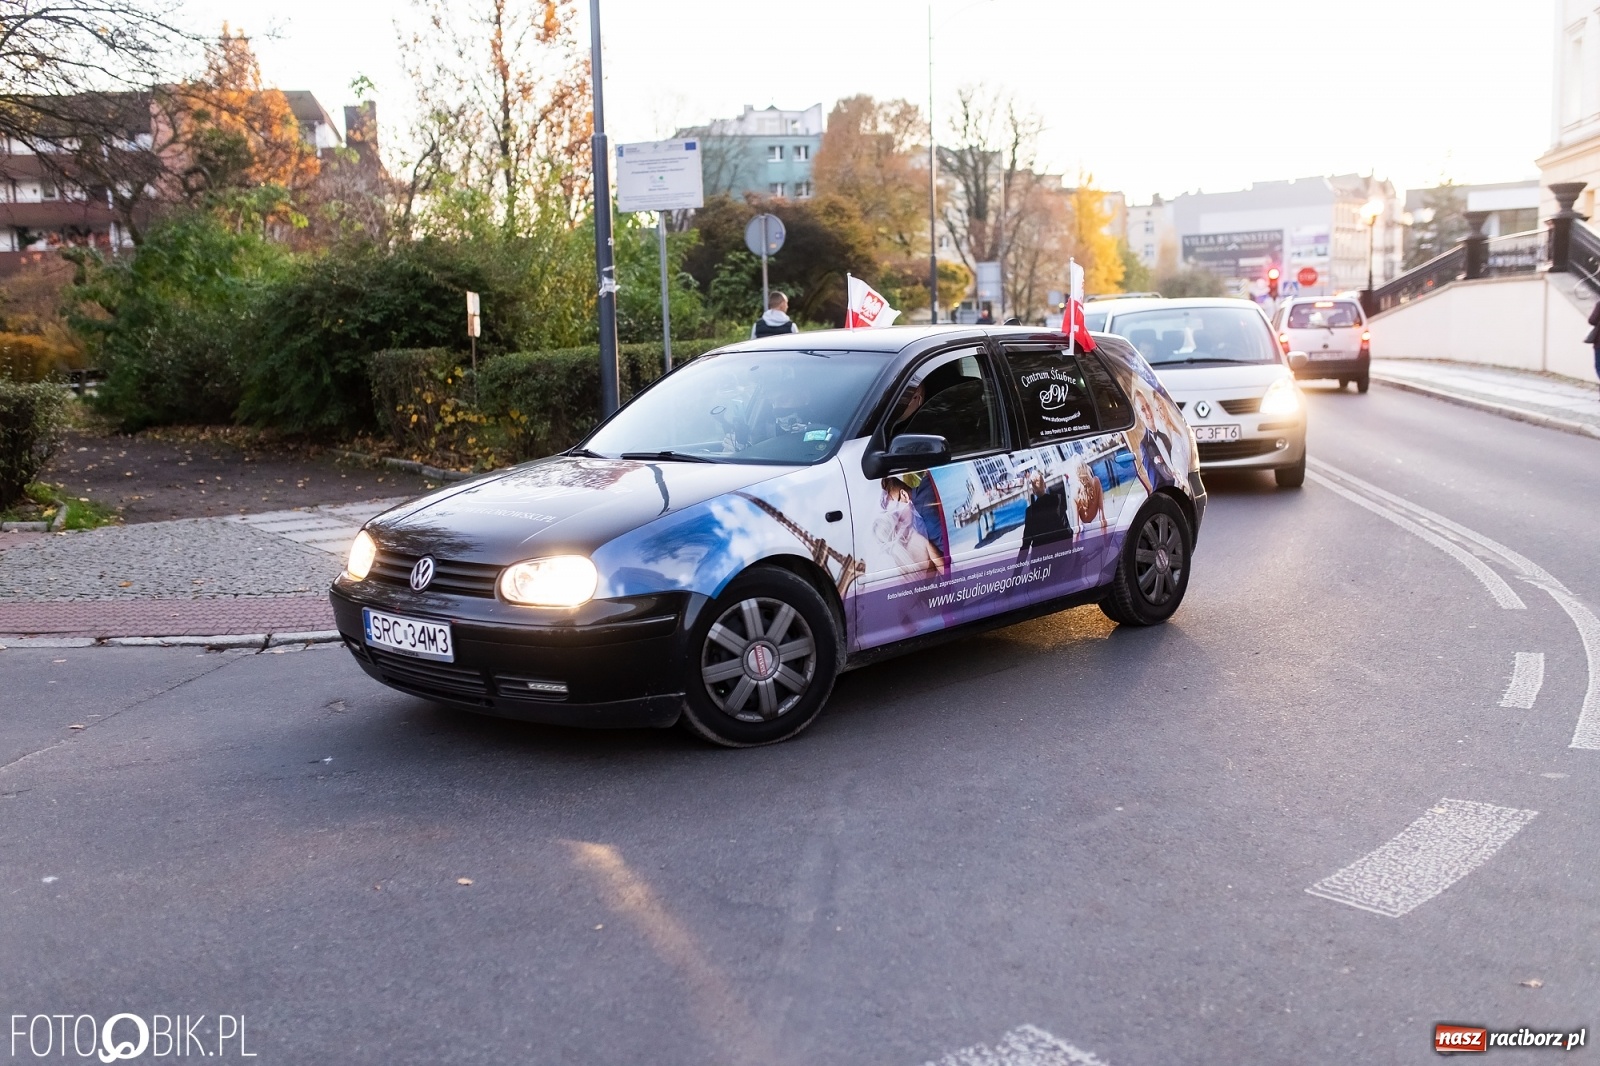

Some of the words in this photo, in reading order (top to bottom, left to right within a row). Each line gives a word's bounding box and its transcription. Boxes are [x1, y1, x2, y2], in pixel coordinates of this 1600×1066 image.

[1021, 372, 1050, 387] Centrum
[1050, 366, 1076, 385] Ślubne
[1208, 427, 1237, 439] 3FT6
[914, 582, 938, 594] fotobudka,
[939, 575, 966, 588] zaproszenia,
[986, 566, 1006, 577] stylizacja,
[1006, 559, 1029, 571] samochody,
[1030, 556, 1042, 565] nauka
[928, 563, 1052, 609] www.studiowegorowski.pl
[372, 615, 403, 645] SRC
[407, 623, 449, 654] 34M3
